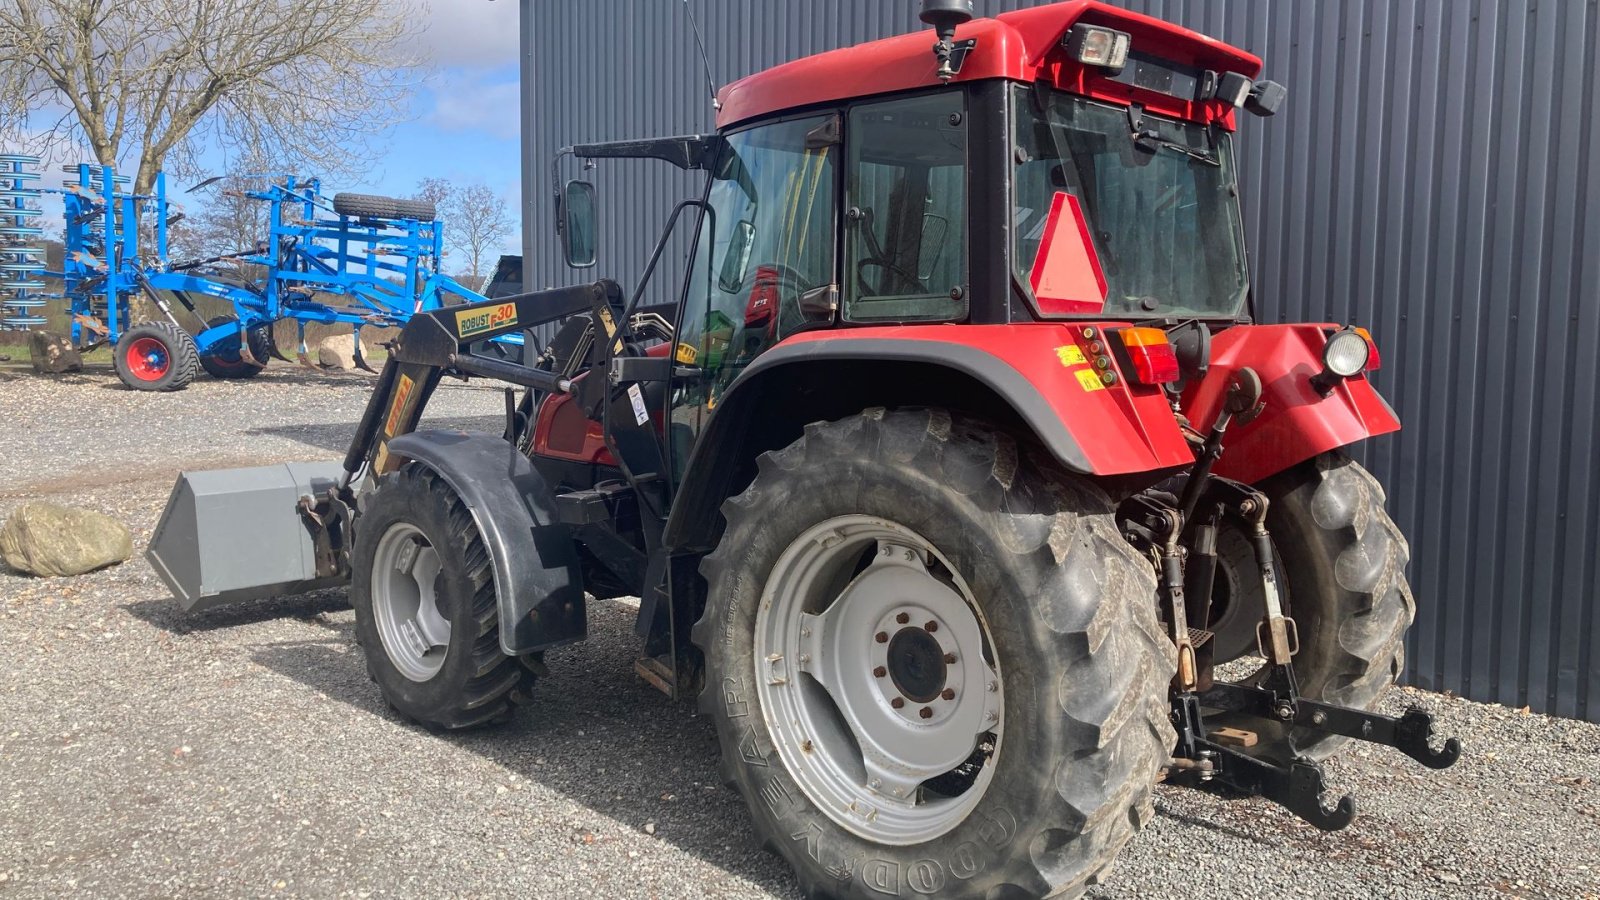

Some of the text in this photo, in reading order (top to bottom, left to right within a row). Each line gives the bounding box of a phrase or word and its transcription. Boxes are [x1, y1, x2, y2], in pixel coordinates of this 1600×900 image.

[461, 304, 513, 331] ROBUST F30
[722, 676, 1017, 896] GOODYEAR
